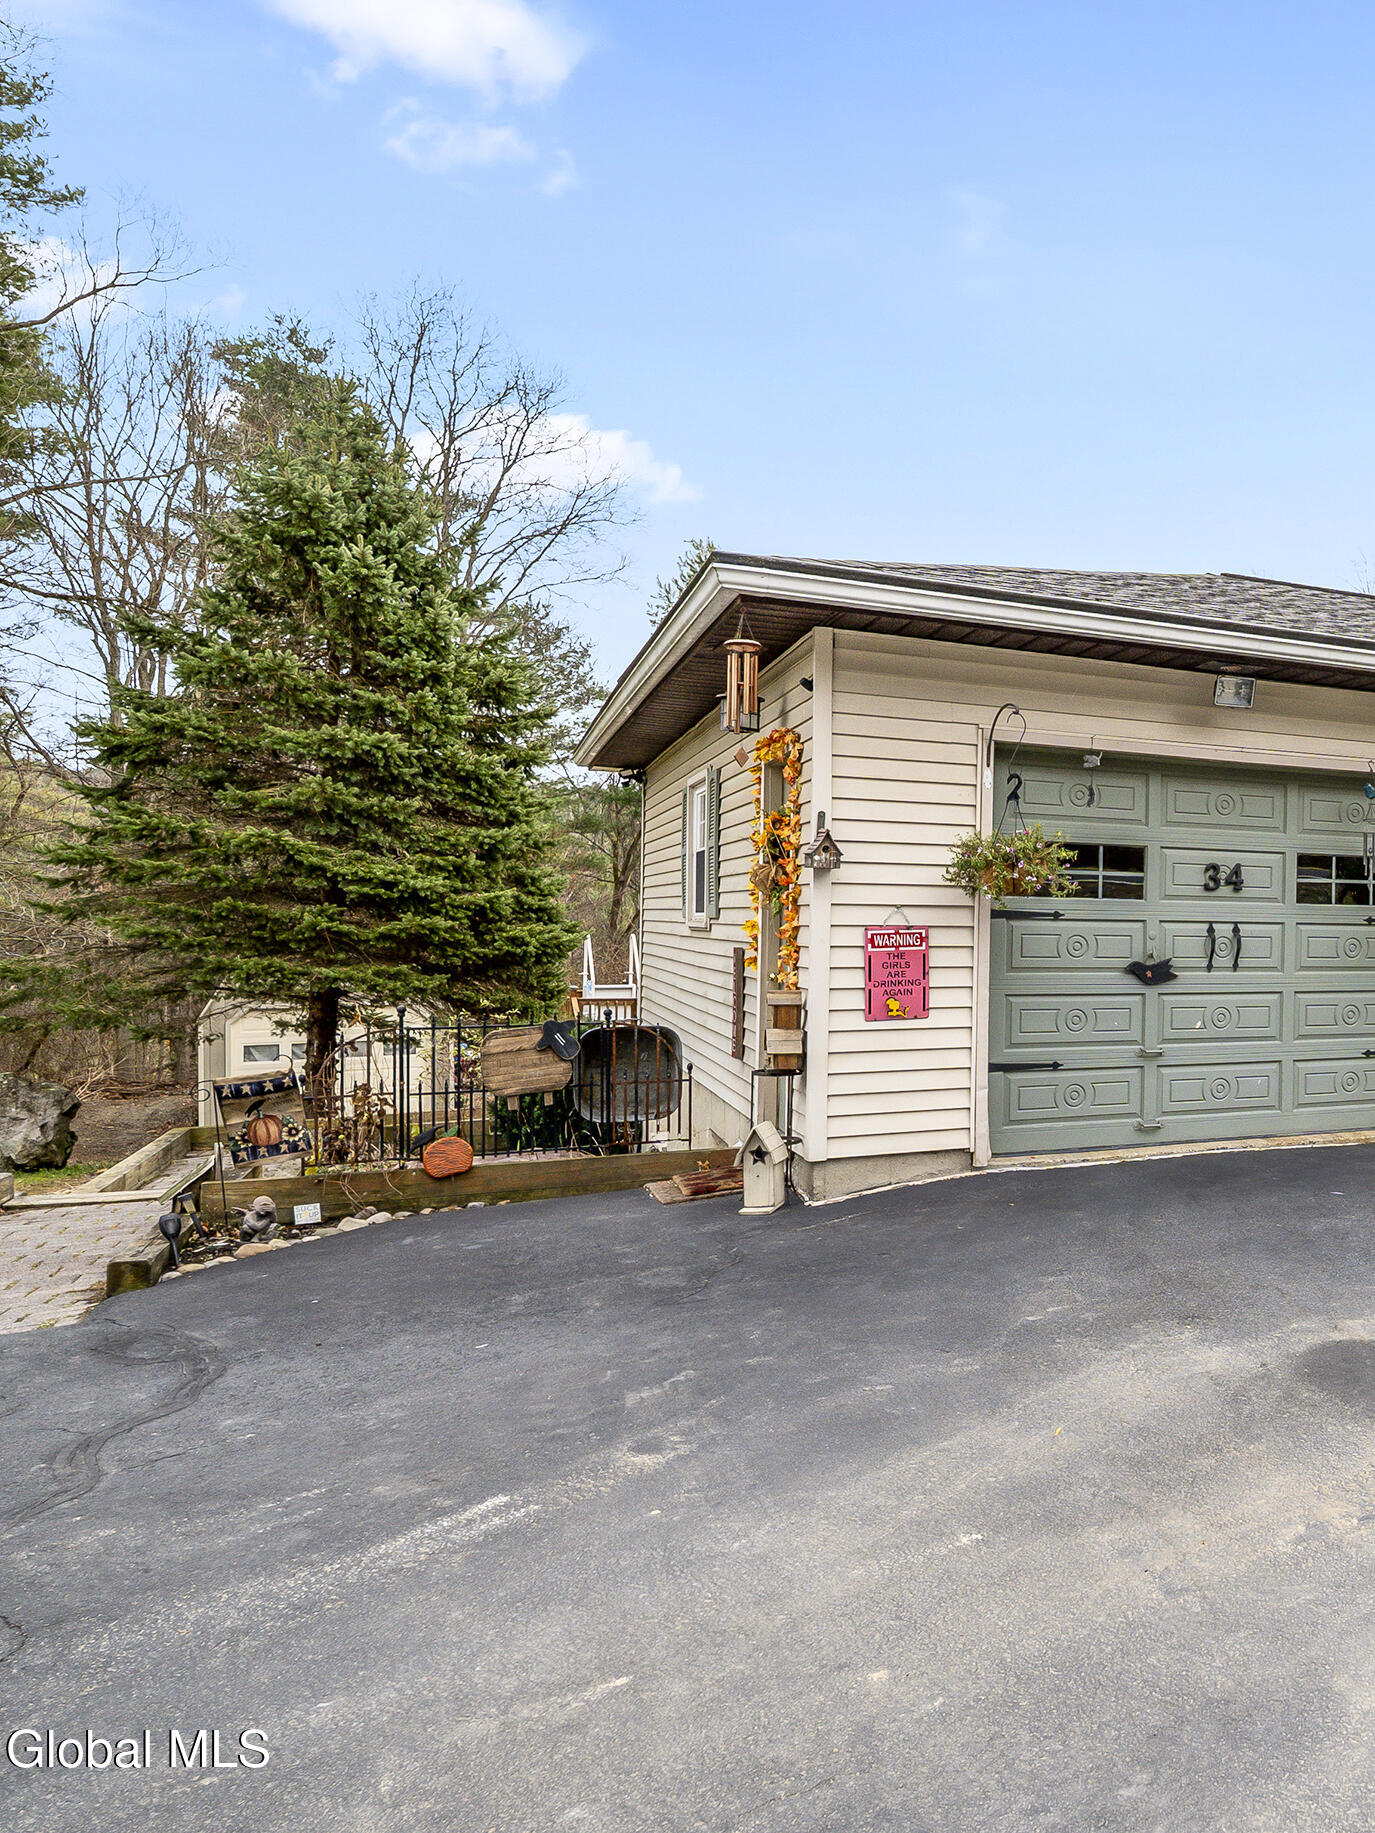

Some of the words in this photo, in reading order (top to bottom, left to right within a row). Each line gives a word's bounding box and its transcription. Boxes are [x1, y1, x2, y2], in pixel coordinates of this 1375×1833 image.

[1203, 862, 1244, 892] 34
[873, 933, 921, 947] WARNING
[887, 952, 906, 960] THE
[881, 961, 911, 970] GIRLS
[886, 970, 907, 979] ARE
[873, 978, 922, 989] DRINKING
[882, 988, 913, 997] AGAIN
[296, 1204, 319, 1213] SUCK
[308, 1210, 320, 1218] UP
